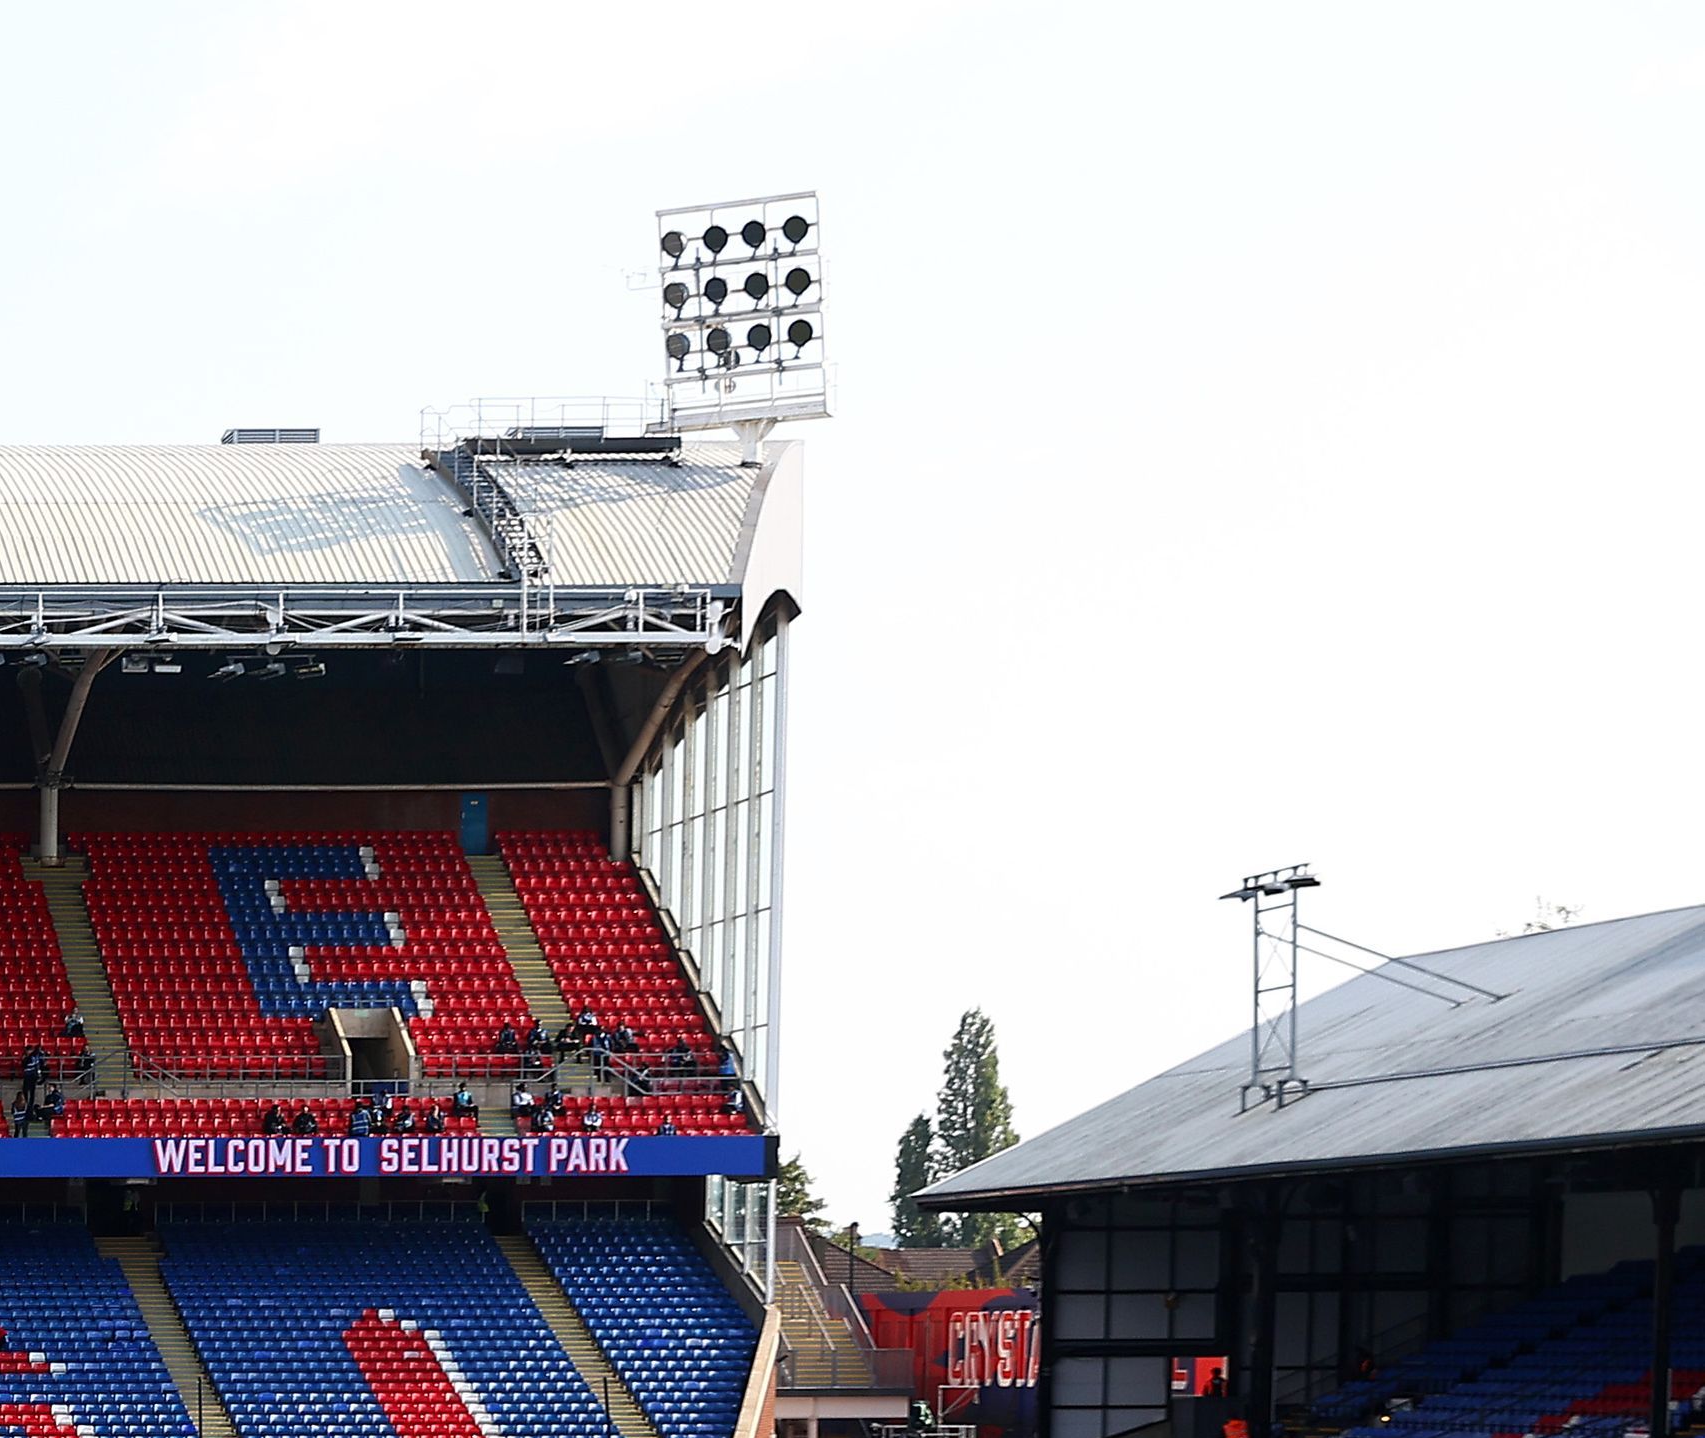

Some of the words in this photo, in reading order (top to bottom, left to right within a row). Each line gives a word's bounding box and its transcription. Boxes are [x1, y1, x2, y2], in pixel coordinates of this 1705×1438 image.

[155, 1138, 313, 1174] WELCOME
[323, 1138, 360, 1173] TO
[380, 1138, 539, 1173] SELHURST
[549, 1137, 629, 1172] PARK
